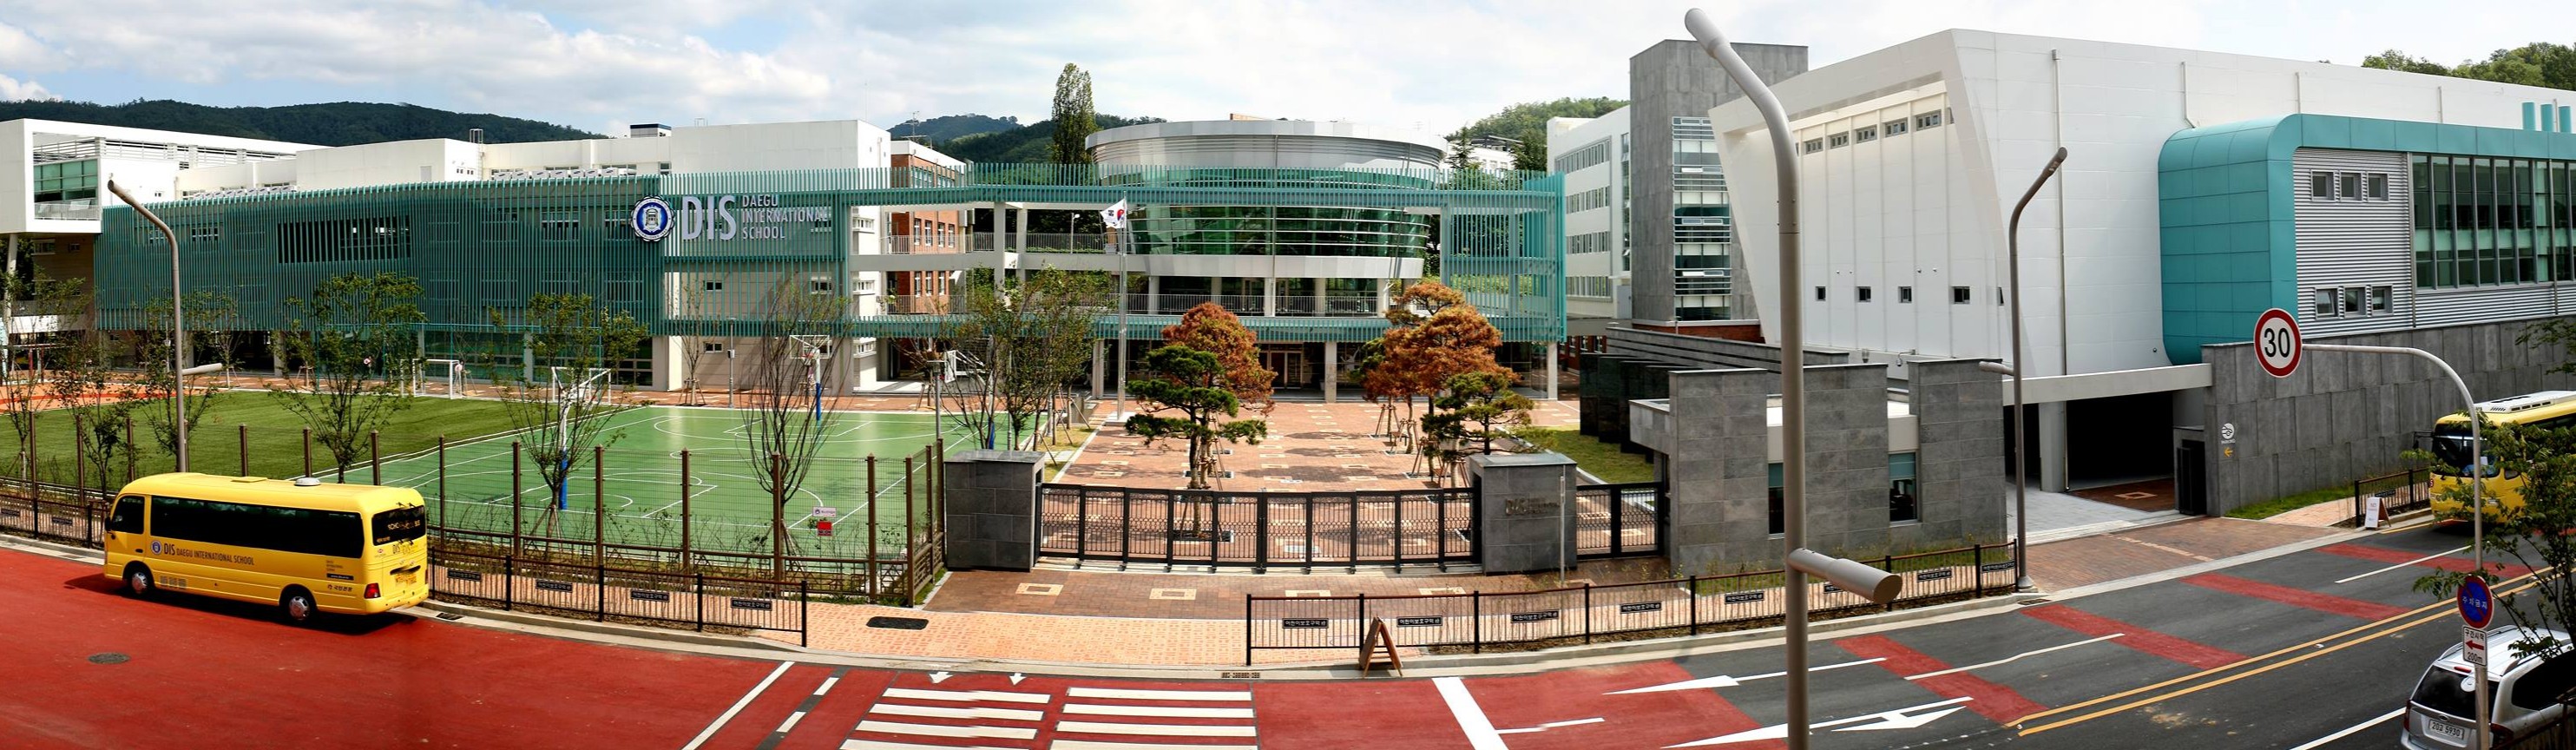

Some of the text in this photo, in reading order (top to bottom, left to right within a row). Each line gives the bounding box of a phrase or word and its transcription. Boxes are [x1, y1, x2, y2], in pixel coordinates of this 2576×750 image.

[742, 194, 779, 207] DAEGU
[682, 195, 737, 240] DIS
[742, 209, 828, 223] INTERNATIONAL
[742, 227, 785, 240] SCHOOL
[2264, 327, 2290, 358] 30
[163, 543, 254, 566] DIS DAEGU INTERNATIONAL SCHOOL
[2462, 595, 2487, 609] 주차금지
[2465, 628, 2485, 641] 구간시작
[2467, 652, 2483, 663] 200m
